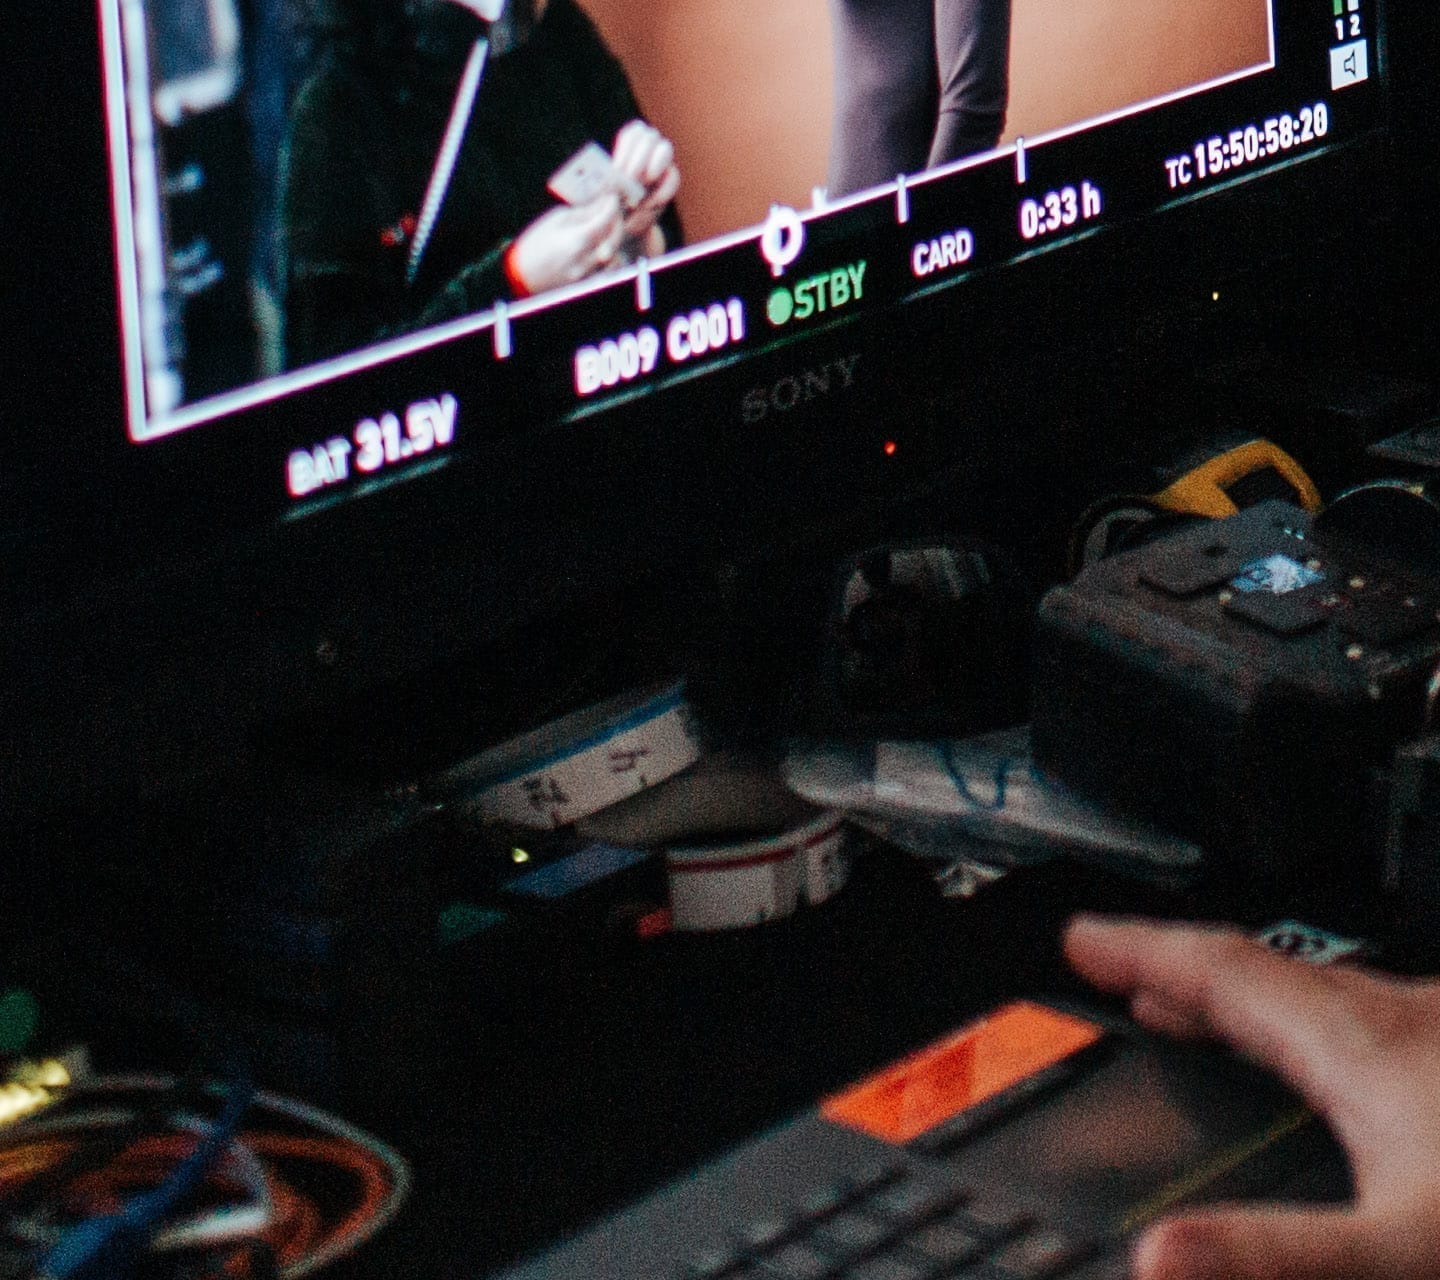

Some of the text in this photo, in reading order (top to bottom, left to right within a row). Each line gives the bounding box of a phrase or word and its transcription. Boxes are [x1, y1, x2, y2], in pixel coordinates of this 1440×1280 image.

[286, 101, 1329, 498] BAT 31.5V B009 C001 STBY CARD 0:33 h TC 15:50:58:20
[742, 352, 861, 424] SONY
